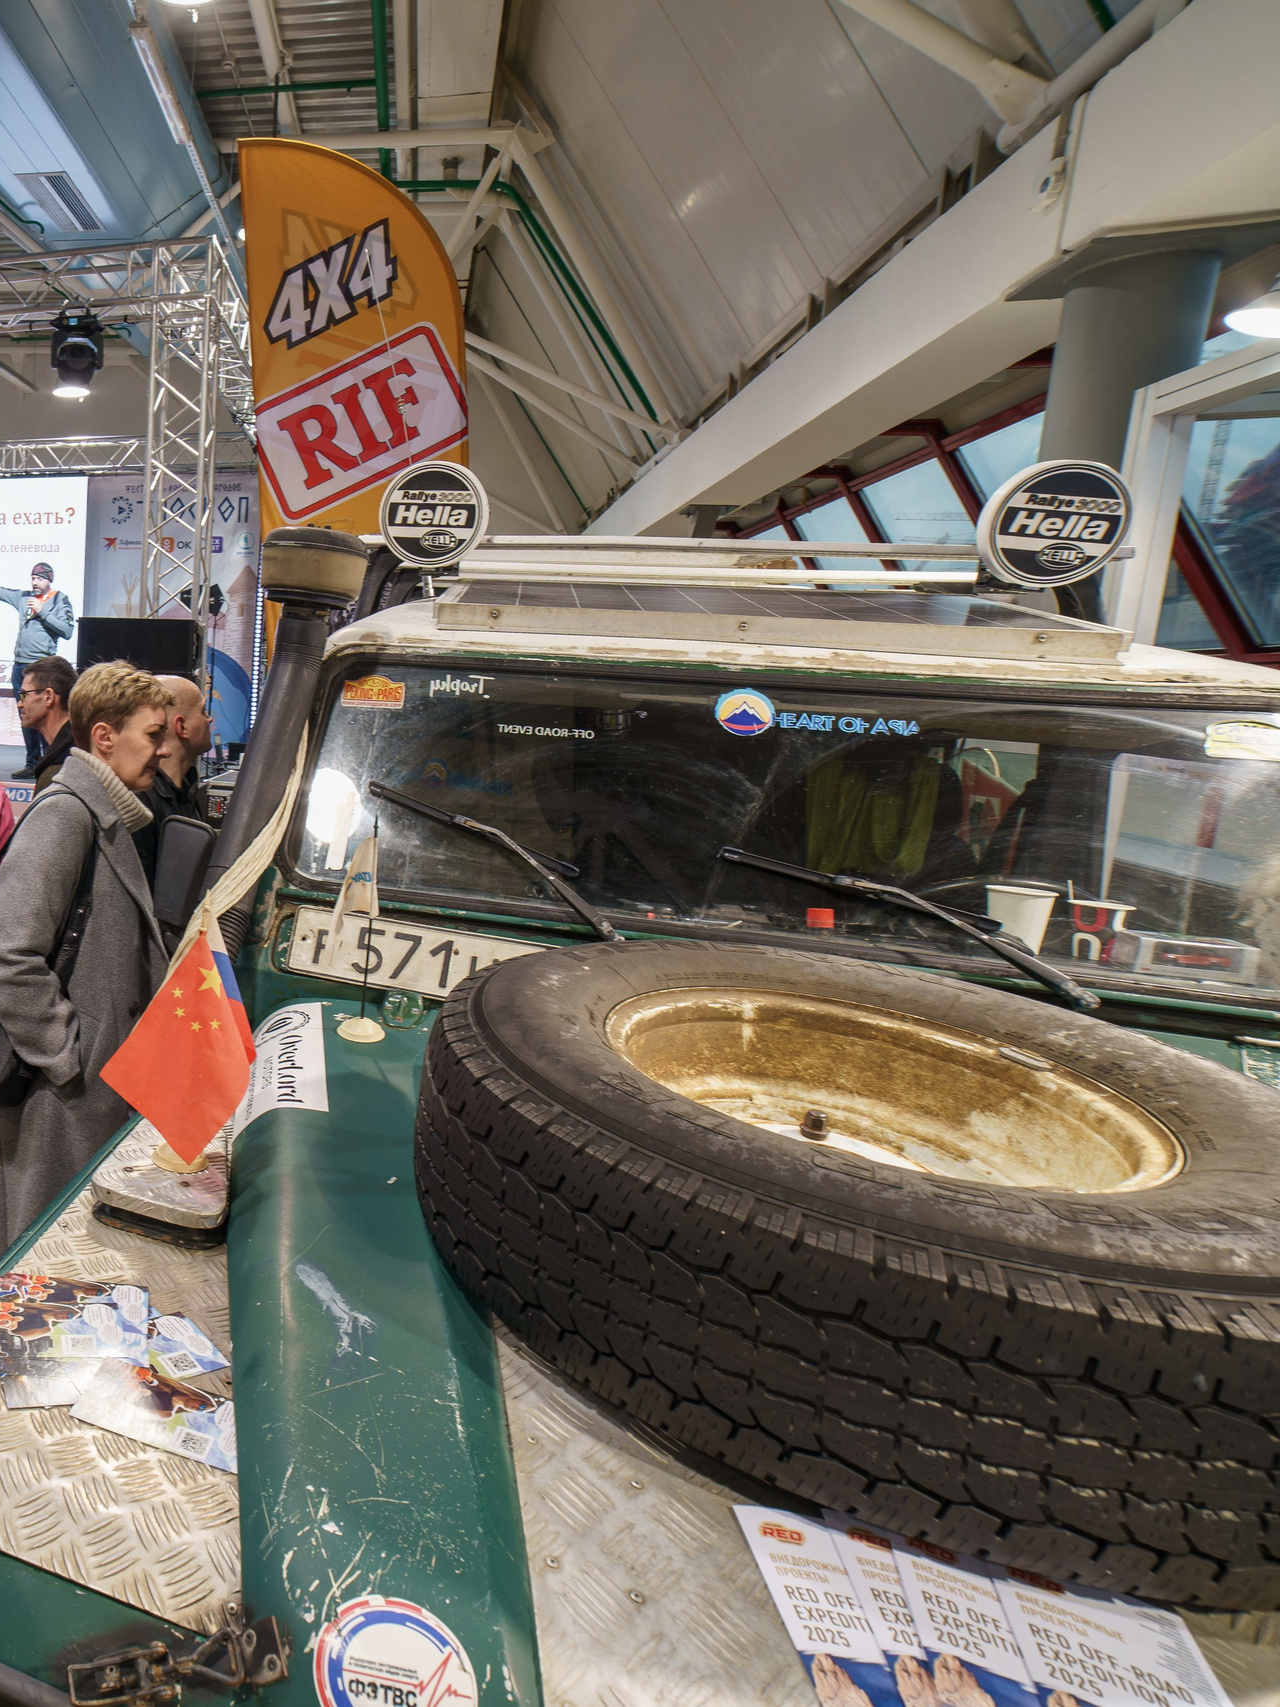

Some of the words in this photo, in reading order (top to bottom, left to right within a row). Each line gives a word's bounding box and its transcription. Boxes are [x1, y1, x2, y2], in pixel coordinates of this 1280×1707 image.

[263, 218, 398, 350] 4X4
[277, 358, 420, 490] RIF
[402, 491, 437, 502] Rallye
[438, 492, 473, 502] 3000
[1025, 493, 1075, 509] Rallye
[1075, 498, 1122, 513] 3000
[13, 507, 76, 525] ехать?
[394, 505, 469, 526] Hella
[1008, 510, 1111, 541] Hella
[0, 543, 60, 553] оленевода
[344, 684, 374, 699] PEKING
[377, 685, 403, 701] PARIS
[870, 717, 920, 737] ASIA
[352, 926, 455, 989] 571
[762, 1525, 803, 1542] RED
[850, 1530, 892, 1548] RED
[775, 1566, 830, 1584] ПРОЕКТЫ
[784, 1585, 820, 1604] RED
[870, 1587, 908, 1608] RED
[915, 1572, 977, 1603] ПРОЕКТЫ
[921, 1590, 959, 1615] RED
[1014, 1591, 1126, 1644] ВНЕДОРОЖНЫЕ
[1020, 1605, 1090, 1639] ПРОЕКТЫ
[803, 1625, 851, 1648] 2025
[933, 1627, 986, 1659] 2025
[1027, 1622, 1070, 1650] RED
[1078, 1642, 1195, 1705] OFF-ROAD
[1035, 1642, 1170, 1707] EXPEDITION
[1045, 1661, 1104, 1698] 2025
